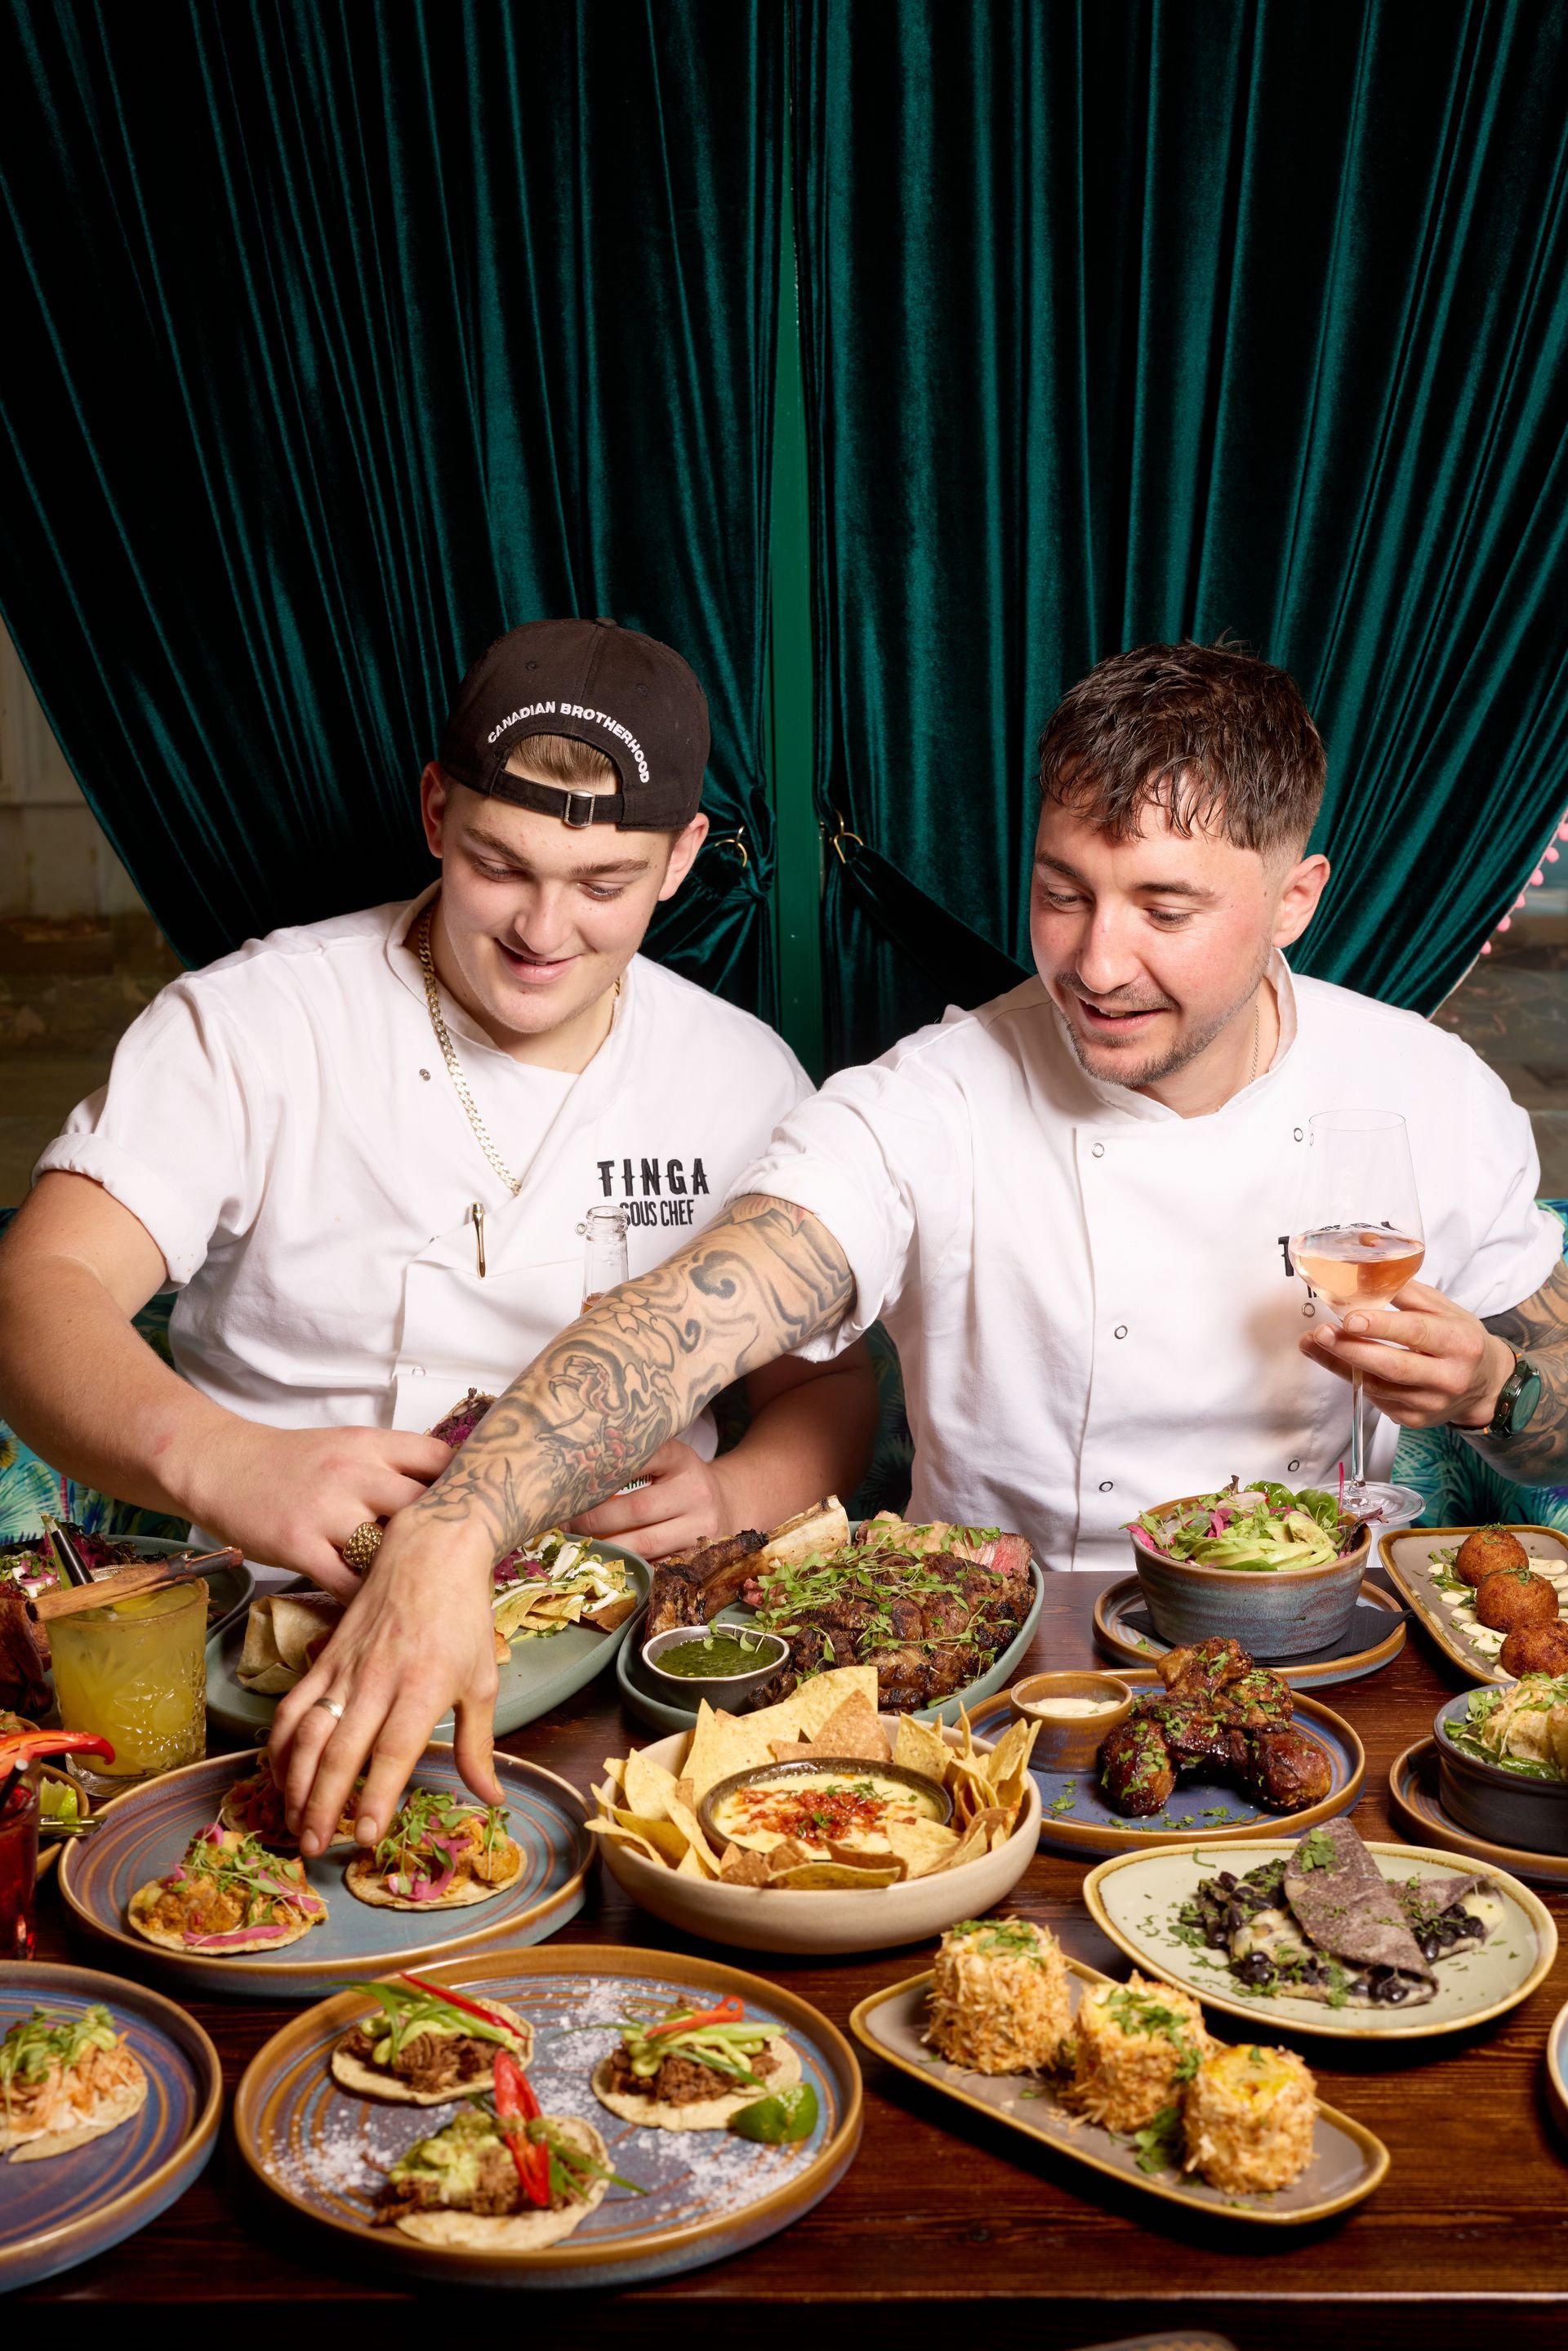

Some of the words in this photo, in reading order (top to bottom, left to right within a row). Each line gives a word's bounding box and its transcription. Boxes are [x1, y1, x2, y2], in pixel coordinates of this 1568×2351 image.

[488, 701, 556, 744] CANADIAN
[559, 702, 650, 784] BROTHERHOOD
[597, 1158, 710, 1197] TINGA
[660, 1199, 694, 1227] CHEF
